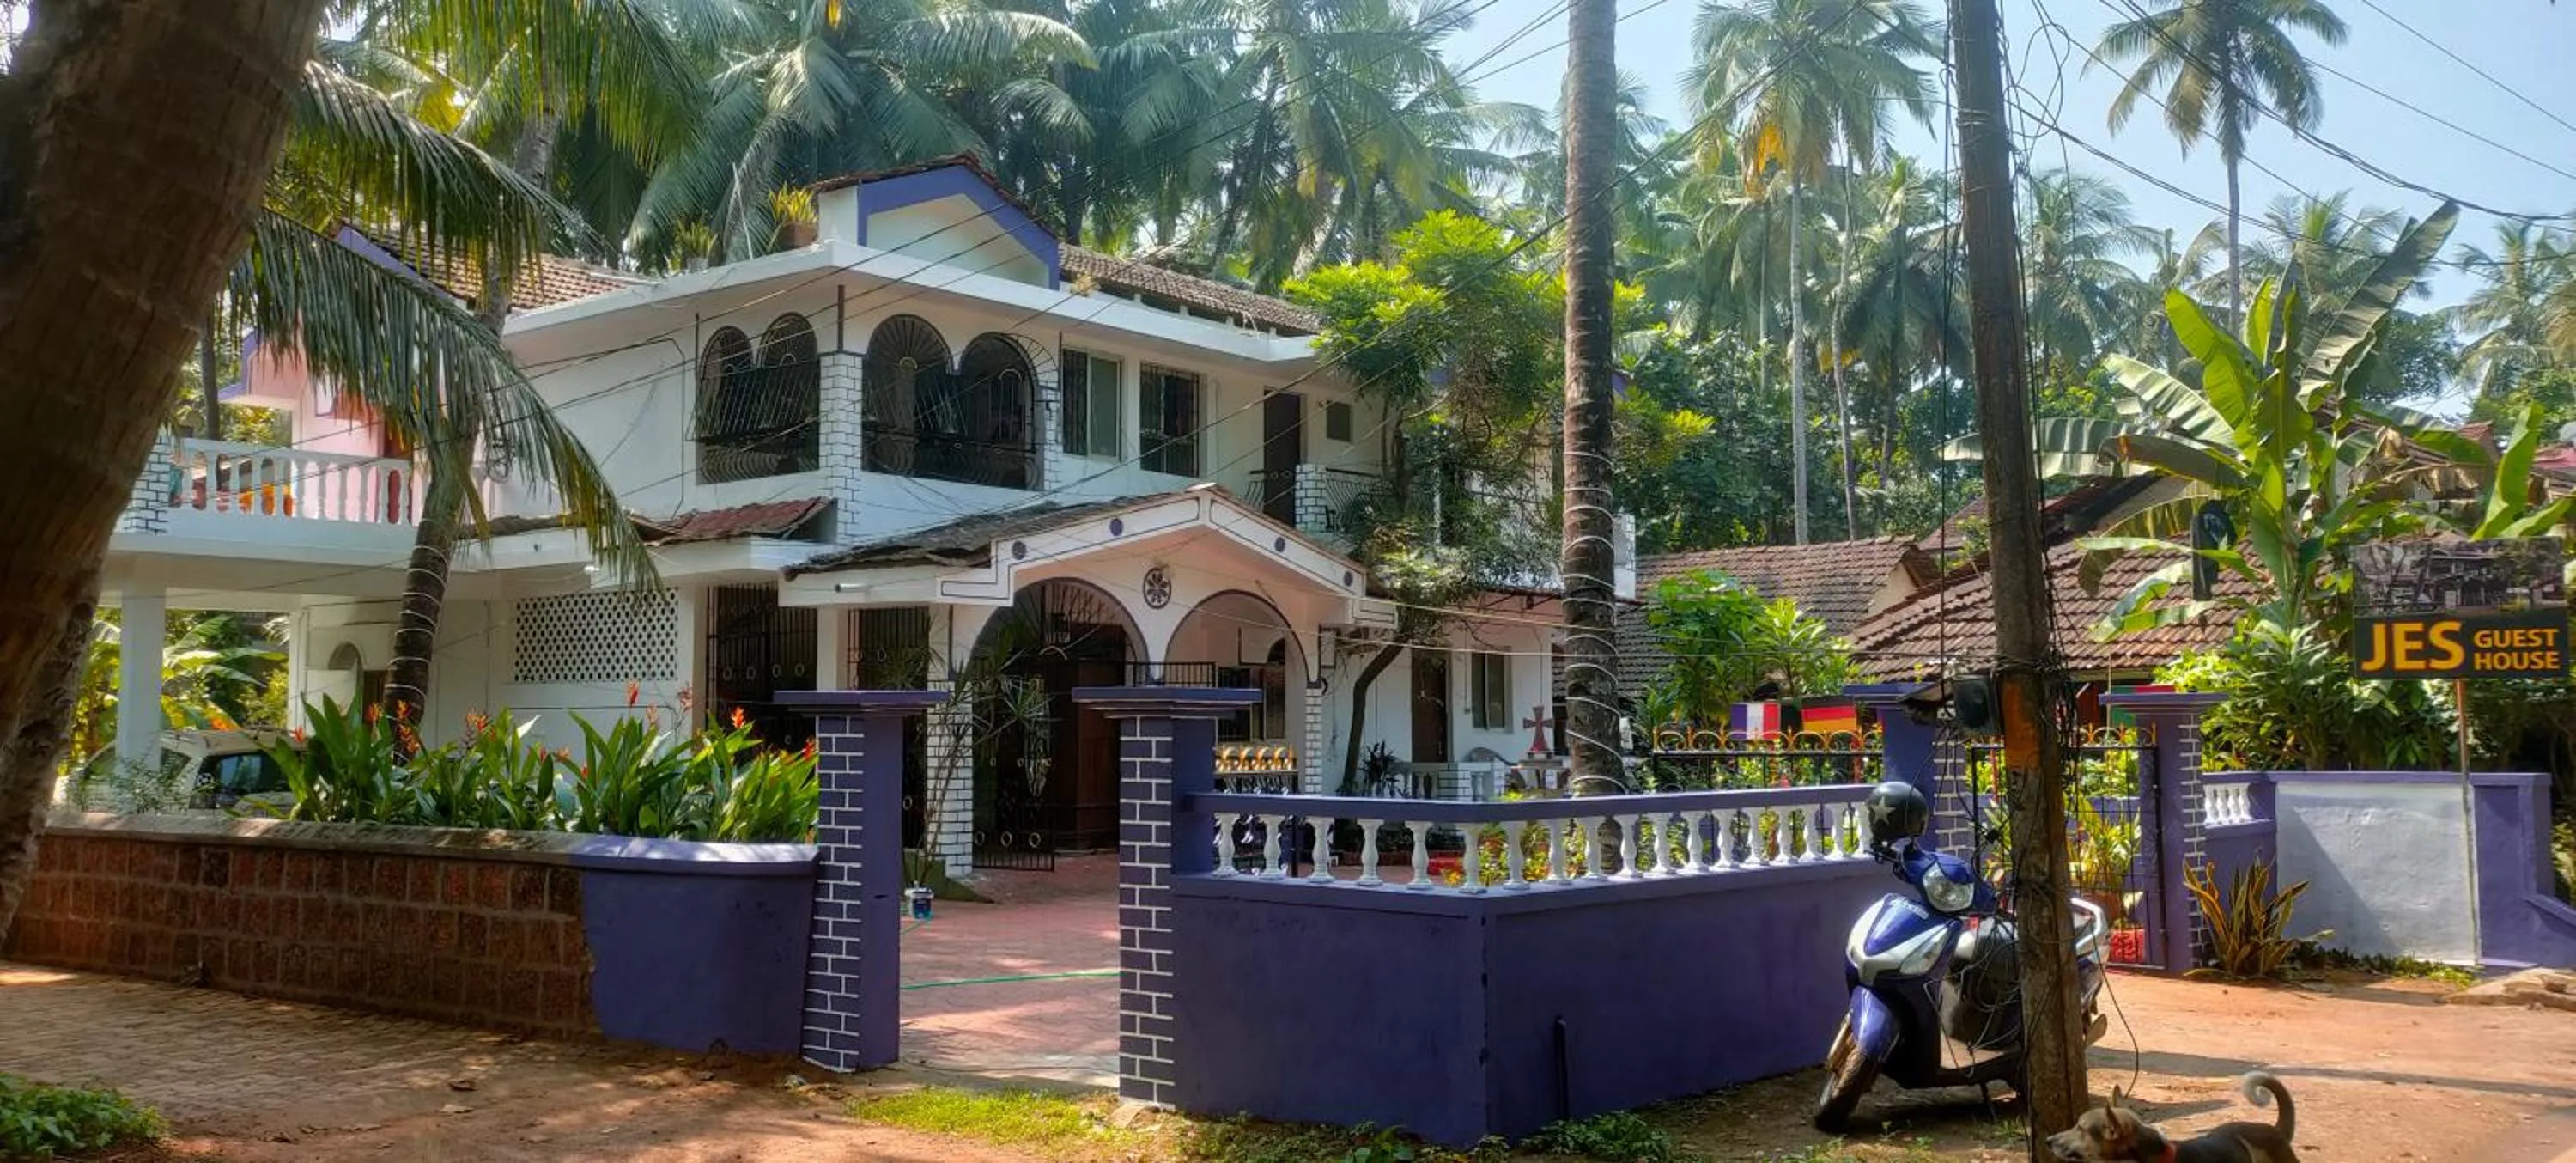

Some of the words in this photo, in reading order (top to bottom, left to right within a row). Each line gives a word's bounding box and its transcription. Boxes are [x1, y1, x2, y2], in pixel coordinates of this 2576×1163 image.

[2361, 620, 2465, 672] JES
[2474, 628, 2559, 648] GUEST
[2474, 651, 2561, 670] HOUSE
